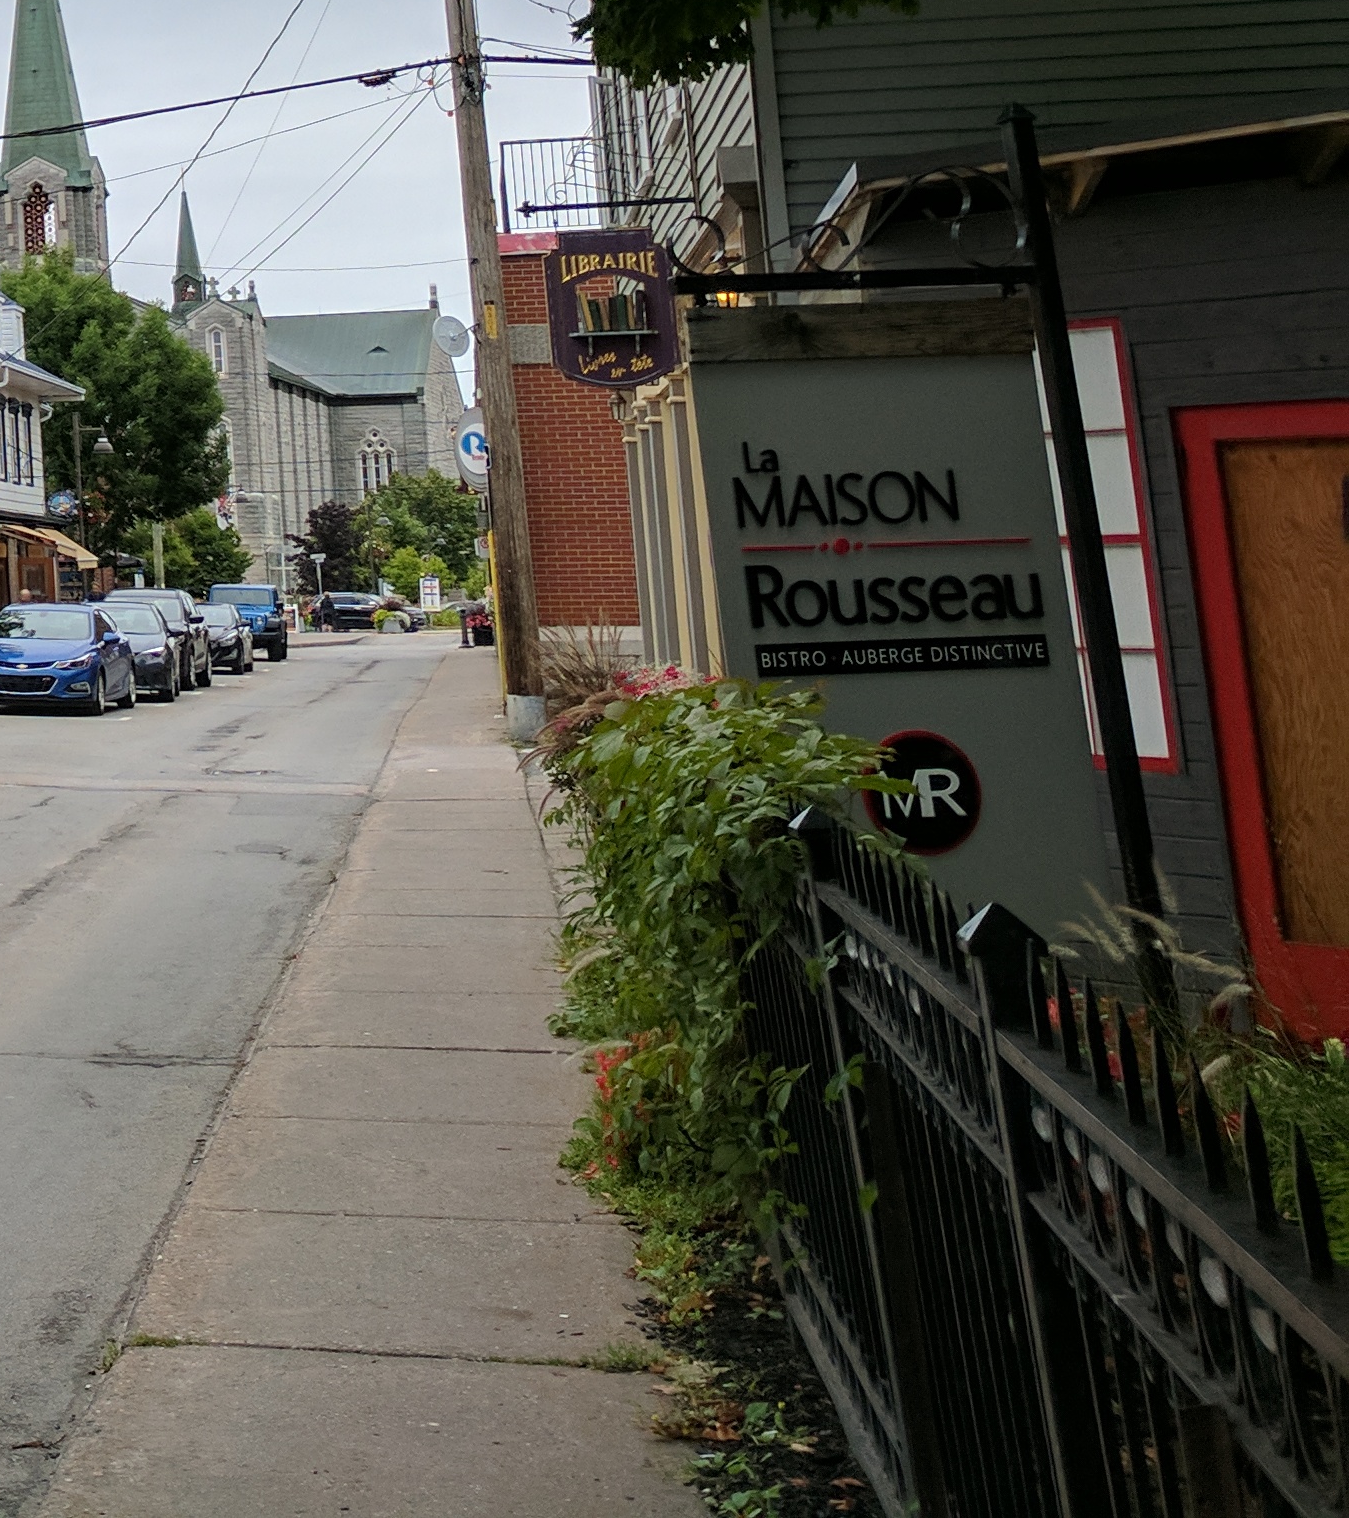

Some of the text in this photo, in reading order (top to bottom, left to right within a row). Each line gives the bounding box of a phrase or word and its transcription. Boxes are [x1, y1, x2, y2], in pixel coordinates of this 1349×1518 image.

[560, 251, 659, 284] LIBRAIRIE
[742, 441, 780, 474] La
[730, 469, 960, 529] MAISON
[744, 563, 1045, 630] Rousseau
[761, 642, 1046, 669] BISTRO AUBERGE DISTINCTIVE
